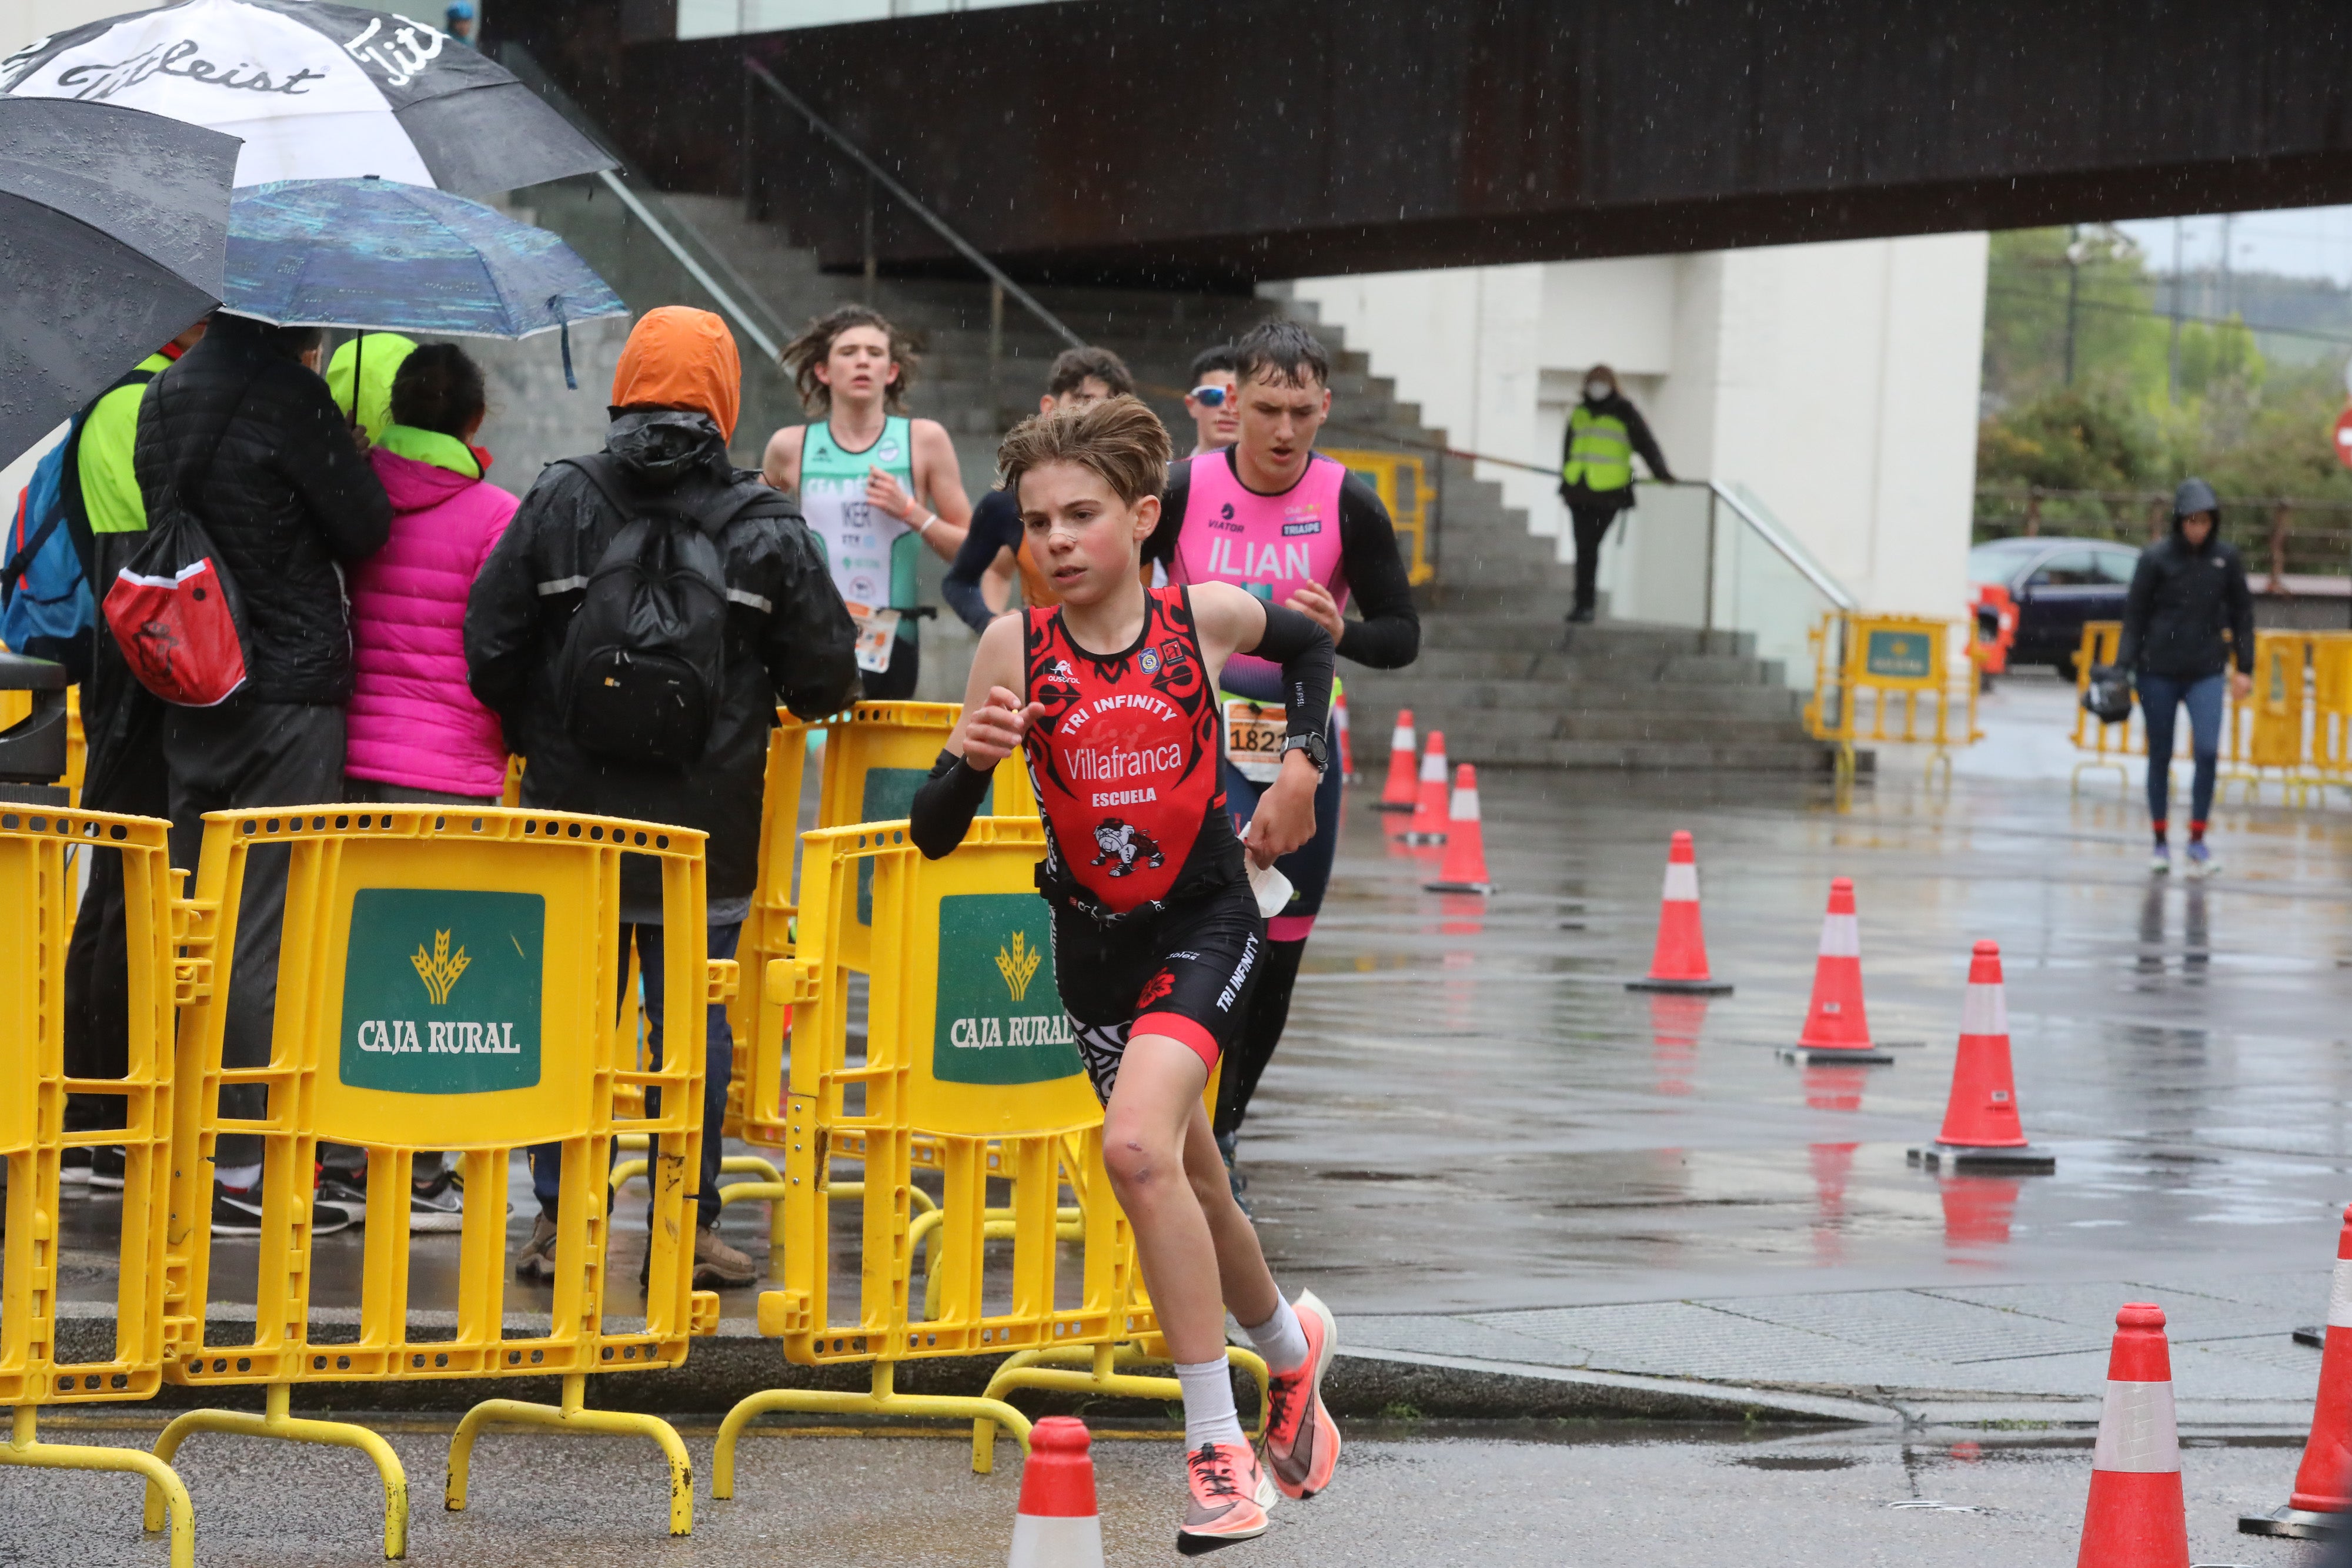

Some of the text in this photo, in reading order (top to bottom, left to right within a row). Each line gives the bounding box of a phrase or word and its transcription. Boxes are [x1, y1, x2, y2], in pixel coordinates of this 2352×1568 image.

[58, 39, 325, 99] Titleist
[1208, 519, 1245, 533] VIATOR
[1208, 536, 1311, 580] ILIAN
[1061, 694, 1177, 735] TRI INFINITY
[1064, 743, 1182, 780] Villafranca
[1092, 787, 1157, 807] ESCUELA
[1216, 932, 1259, 1013] TRI INFINITY
[358, 1020, 520, 1055] CAJA RURAL
[950, 1015, 1075, 1051] CAJA RURAL
